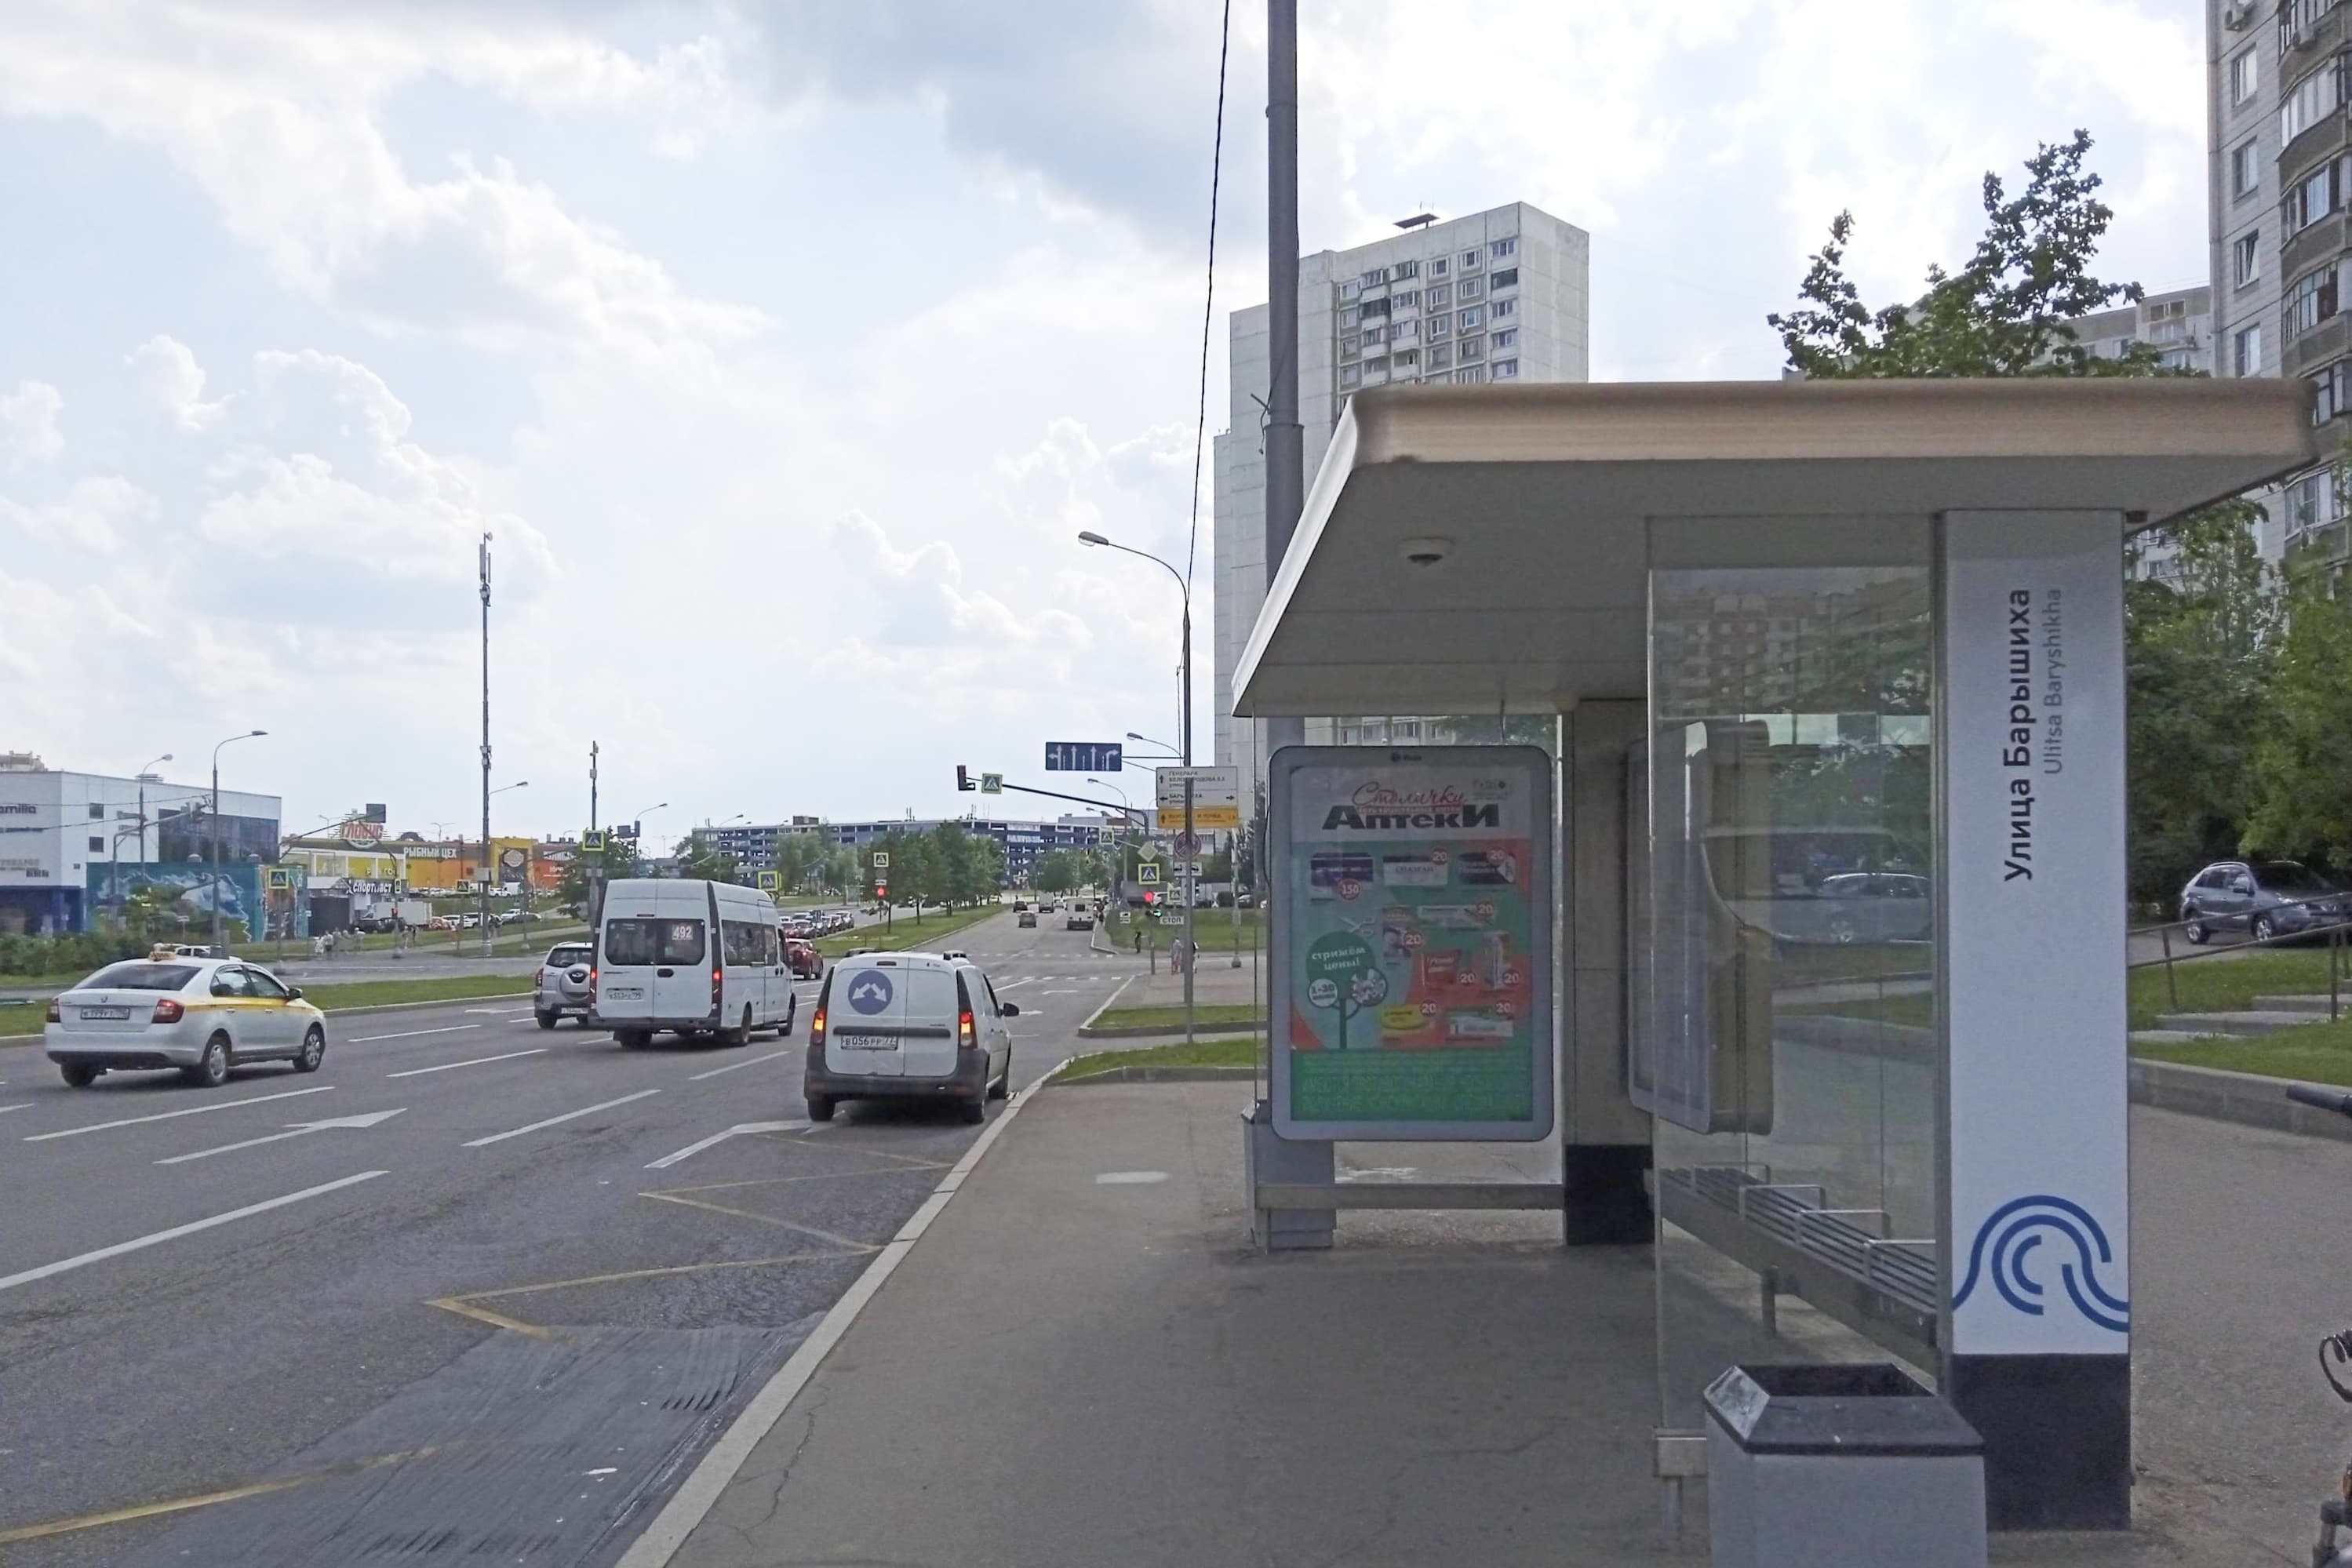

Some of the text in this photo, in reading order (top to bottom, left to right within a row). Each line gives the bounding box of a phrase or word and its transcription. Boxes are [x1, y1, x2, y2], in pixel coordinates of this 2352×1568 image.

[2042, 589, 2066, 774] Ulitsa Baryshikha
[2004, 589, 2037, 881] Улица Барышиха
[403, 846, 457, 859] РЫБНЫЙ ЦЕХ
[674, 926, 692, 939] 492
